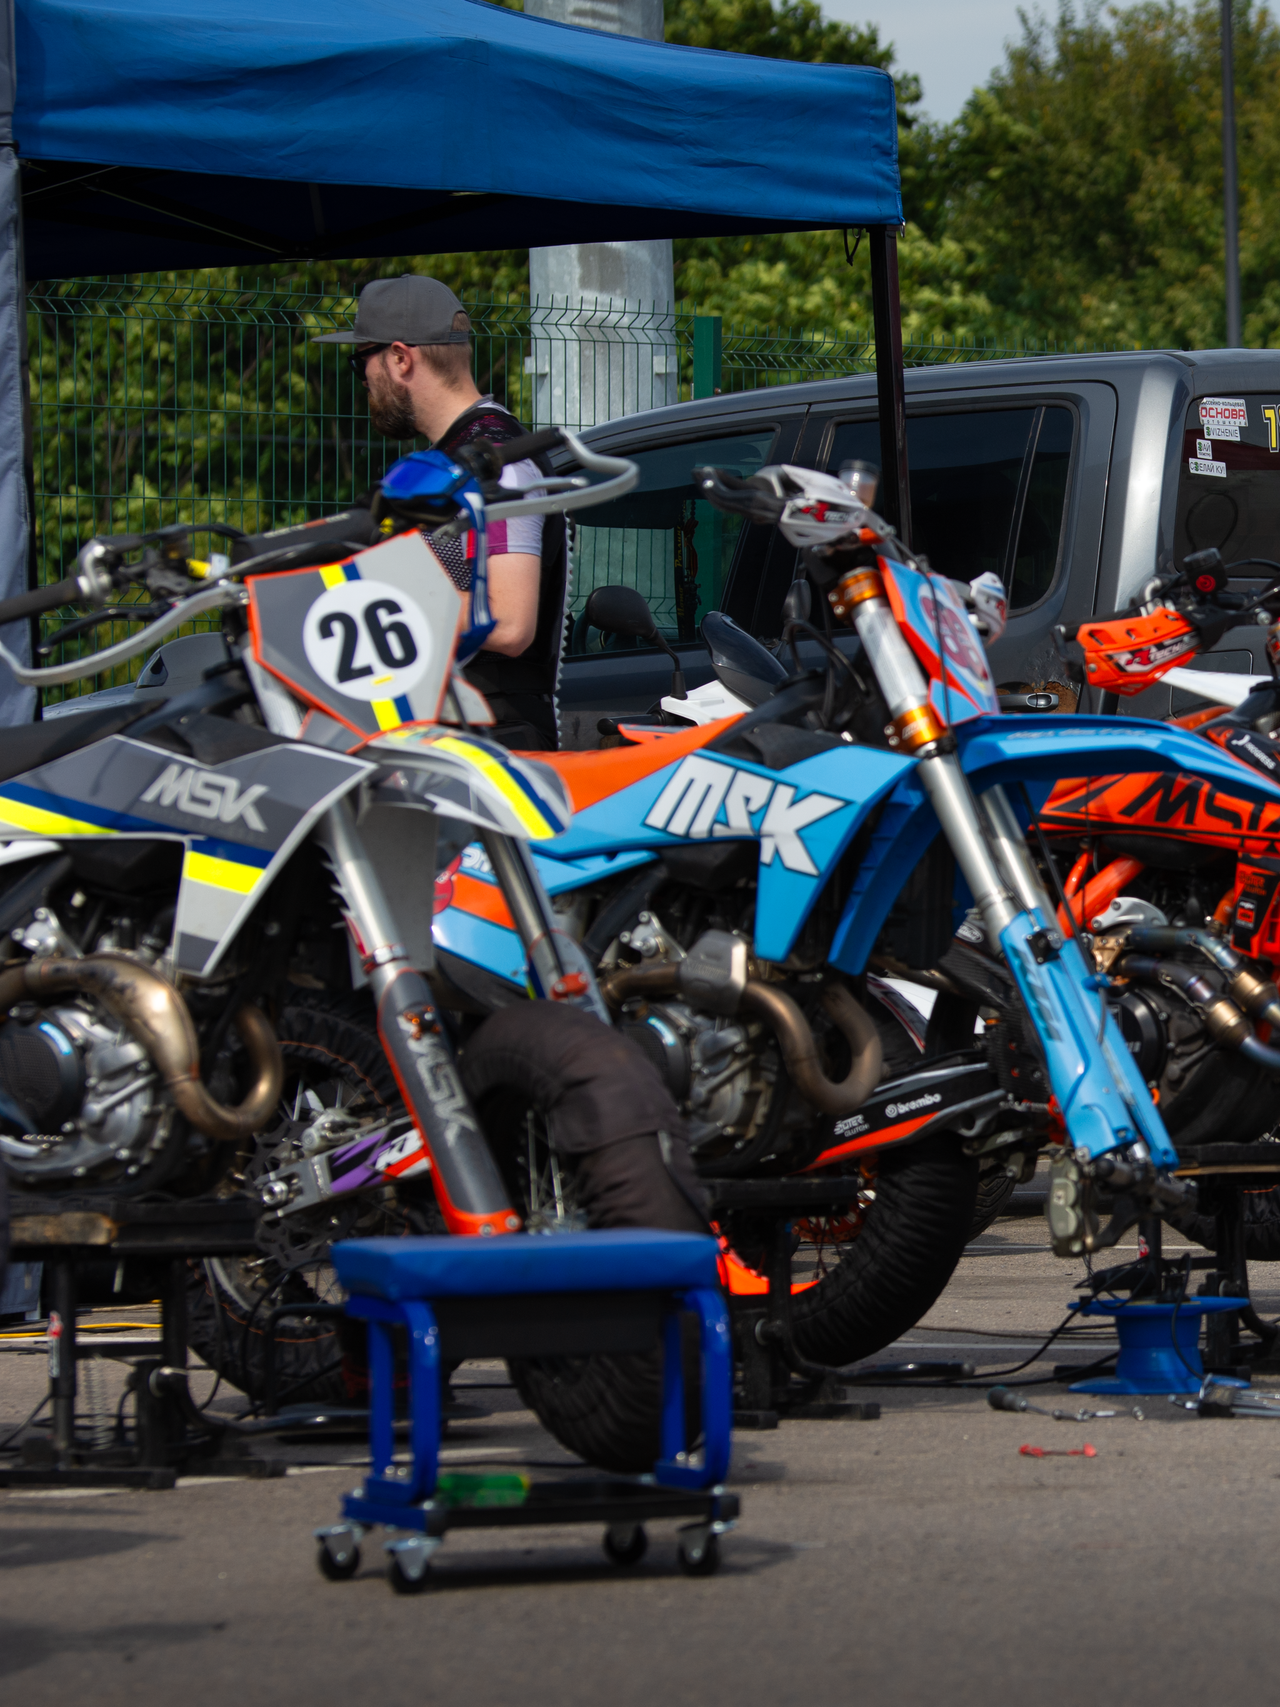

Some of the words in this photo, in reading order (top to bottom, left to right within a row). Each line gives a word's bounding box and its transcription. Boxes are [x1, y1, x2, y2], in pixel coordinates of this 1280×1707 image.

[1200, 407, 1246, 420] ОСНОВА
[319, 598, 417, 684] 26
[139, 763, 270, 833] MSK
[643, 752, 851, 877] MSK
[896, 1092, 942, 1115] brembo
